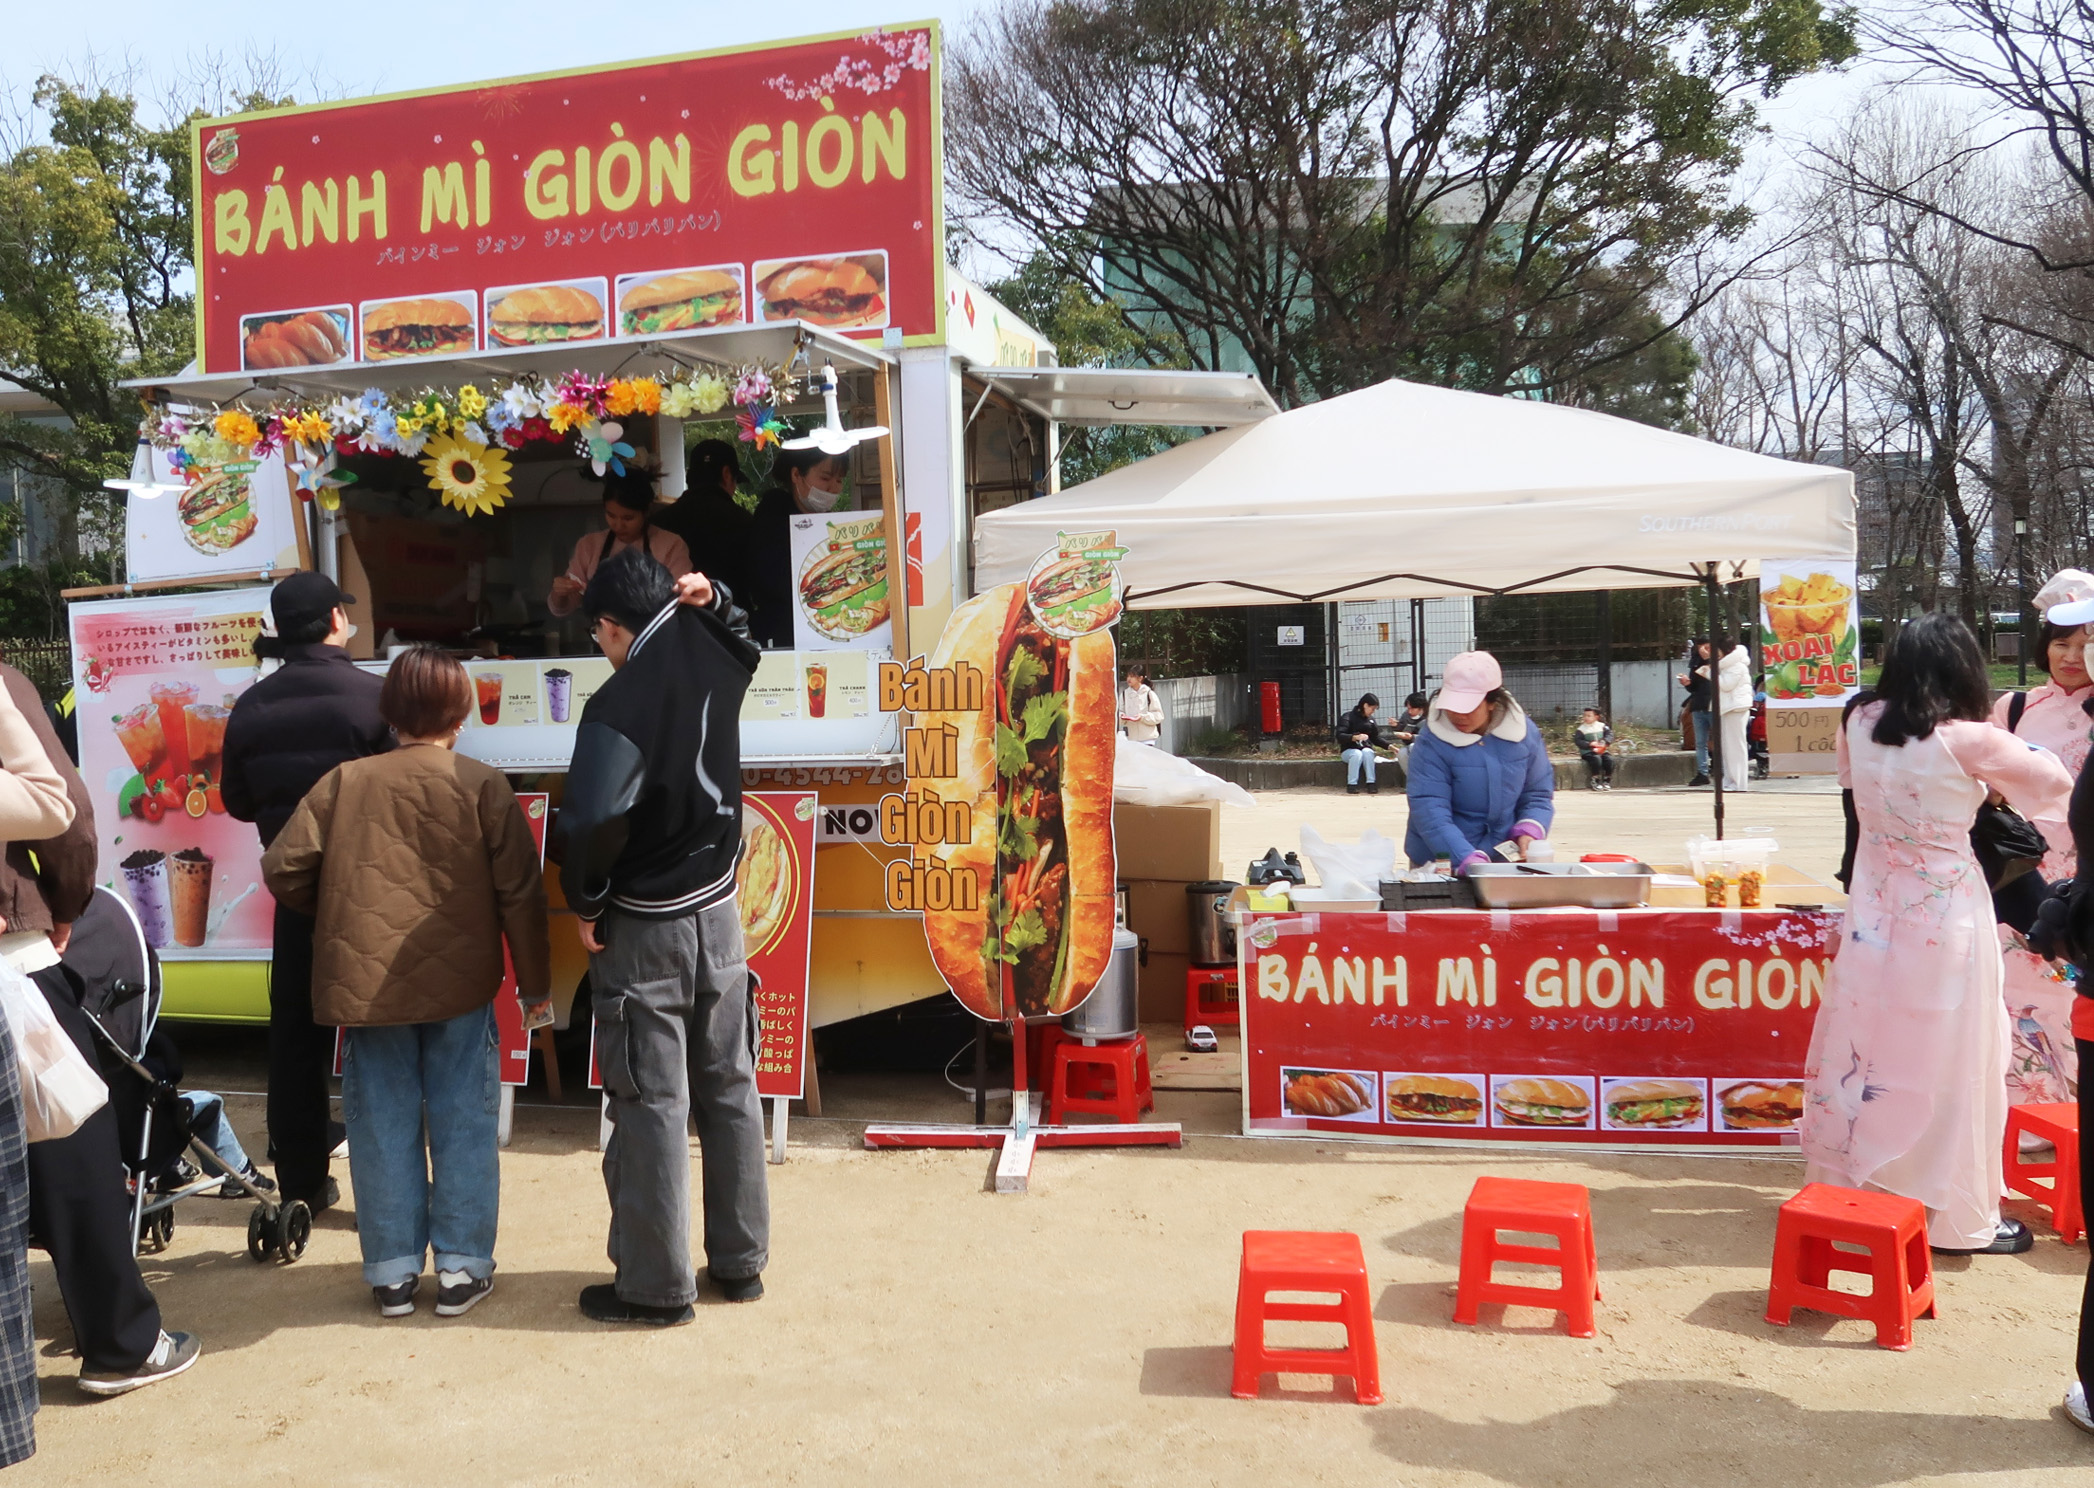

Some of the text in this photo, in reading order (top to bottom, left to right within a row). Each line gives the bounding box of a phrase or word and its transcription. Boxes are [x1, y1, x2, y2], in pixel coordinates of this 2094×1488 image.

[215, 96, 907, 256] BÁNH MÌ GIÒN GIÒN
[97, 617, 261, 639] シロップではなく、新鮮なフルーツを使
[1761, 633, 1835, 666] XOÀI
[879, 655, 983, 712] Bánh
[1776, 711, 1810, 728] 500
[906, 722, 959, 778] Mì
[825, 809, 878, 835] NO
[880, 788, 971, 845] Giòn
[887, 854, 979, 911] Giòn
[1258, 942, 1834, 1009] BÁNH MÌ GIÒN GIÒN
